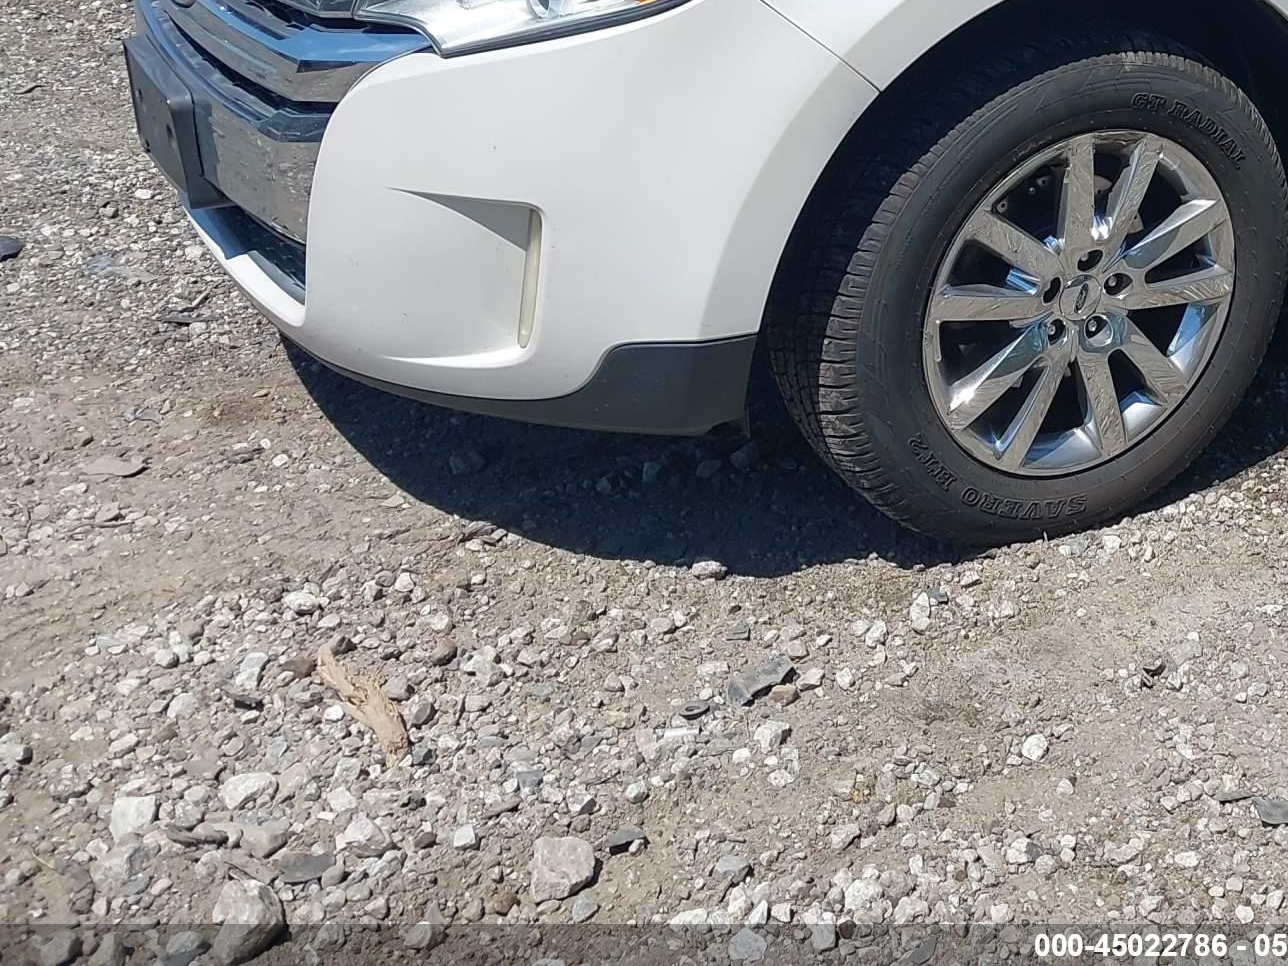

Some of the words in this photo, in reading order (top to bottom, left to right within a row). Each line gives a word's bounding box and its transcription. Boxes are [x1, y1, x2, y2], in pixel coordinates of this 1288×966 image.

[1131, 92, 1168, 112] GT
[1167, 99, 1247, 171] RADIAL
[907, 432, 958, 491] HT2
[960, 485, 1089, 521] SAVERO
